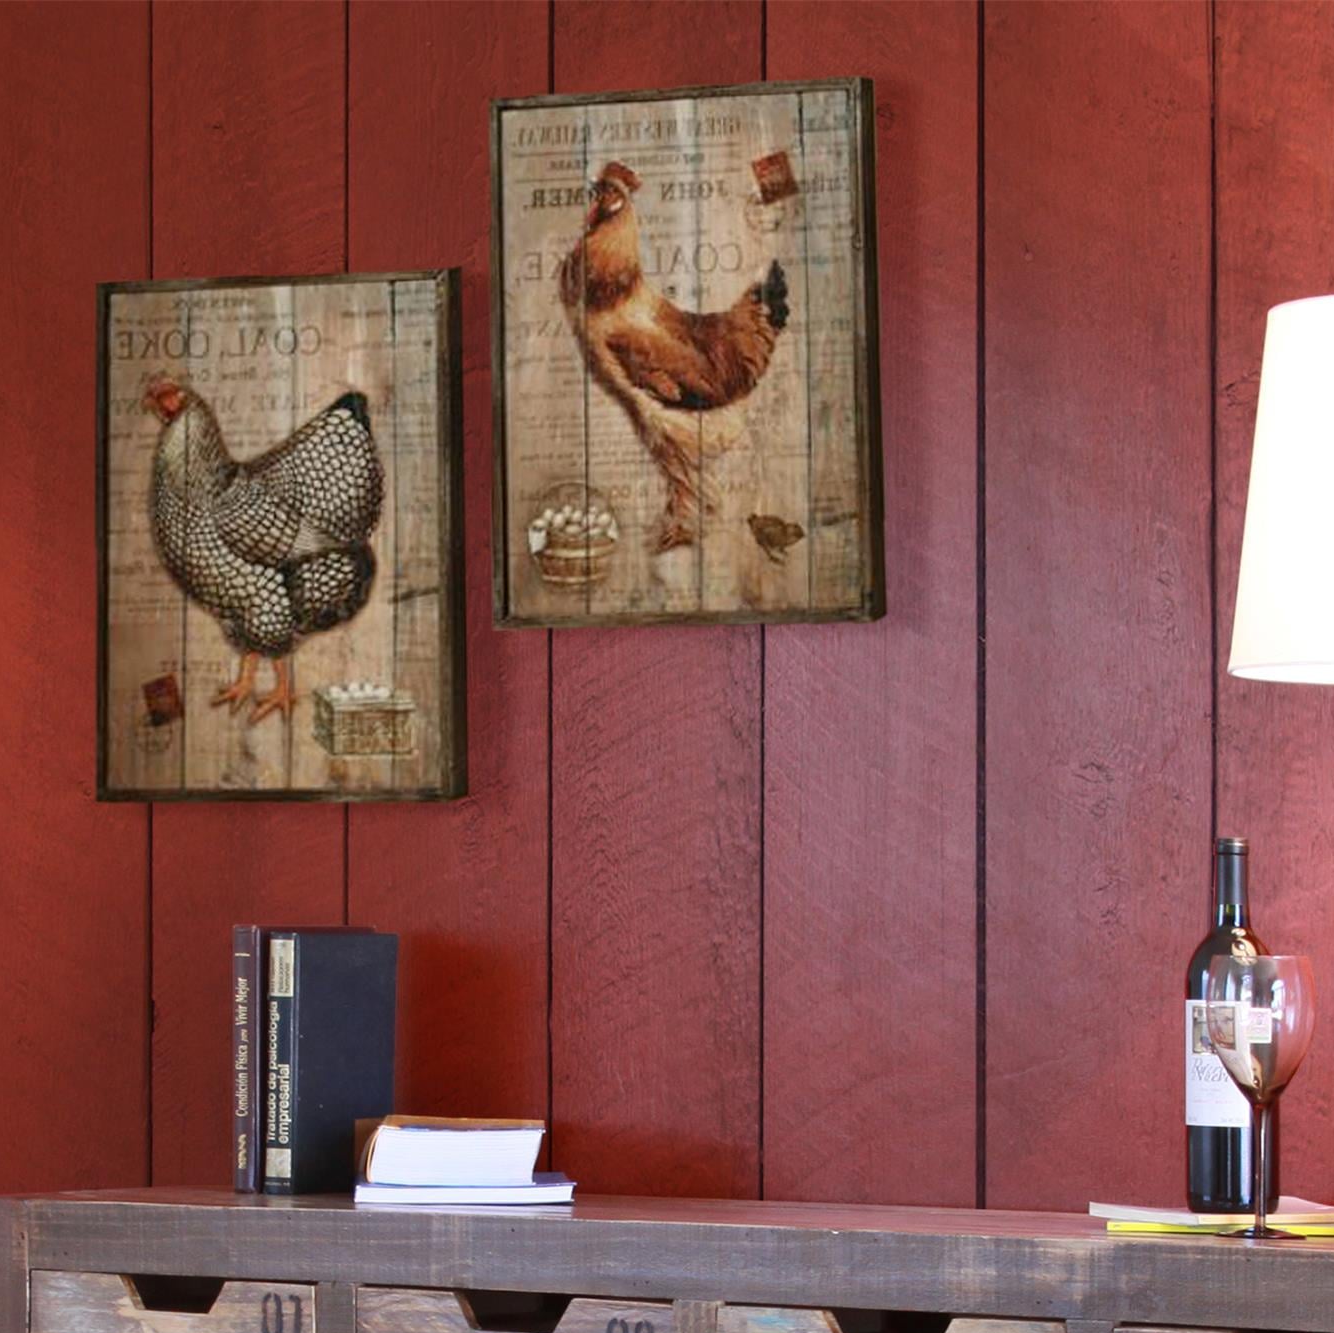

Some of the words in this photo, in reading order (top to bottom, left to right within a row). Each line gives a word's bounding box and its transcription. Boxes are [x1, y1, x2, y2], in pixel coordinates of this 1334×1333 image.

[235, 977, 250, 1004] Mejor
[235, 1005, 249, 1027] Vivir
[235, 1044, 249, 1071] Física
[235, 1072, 249, 1117] Condición
[267, 1073, 278, 1090] de
[267, 1092, 278, 1142] Tratado
[276, 1064, 292, 1144] empresarial
